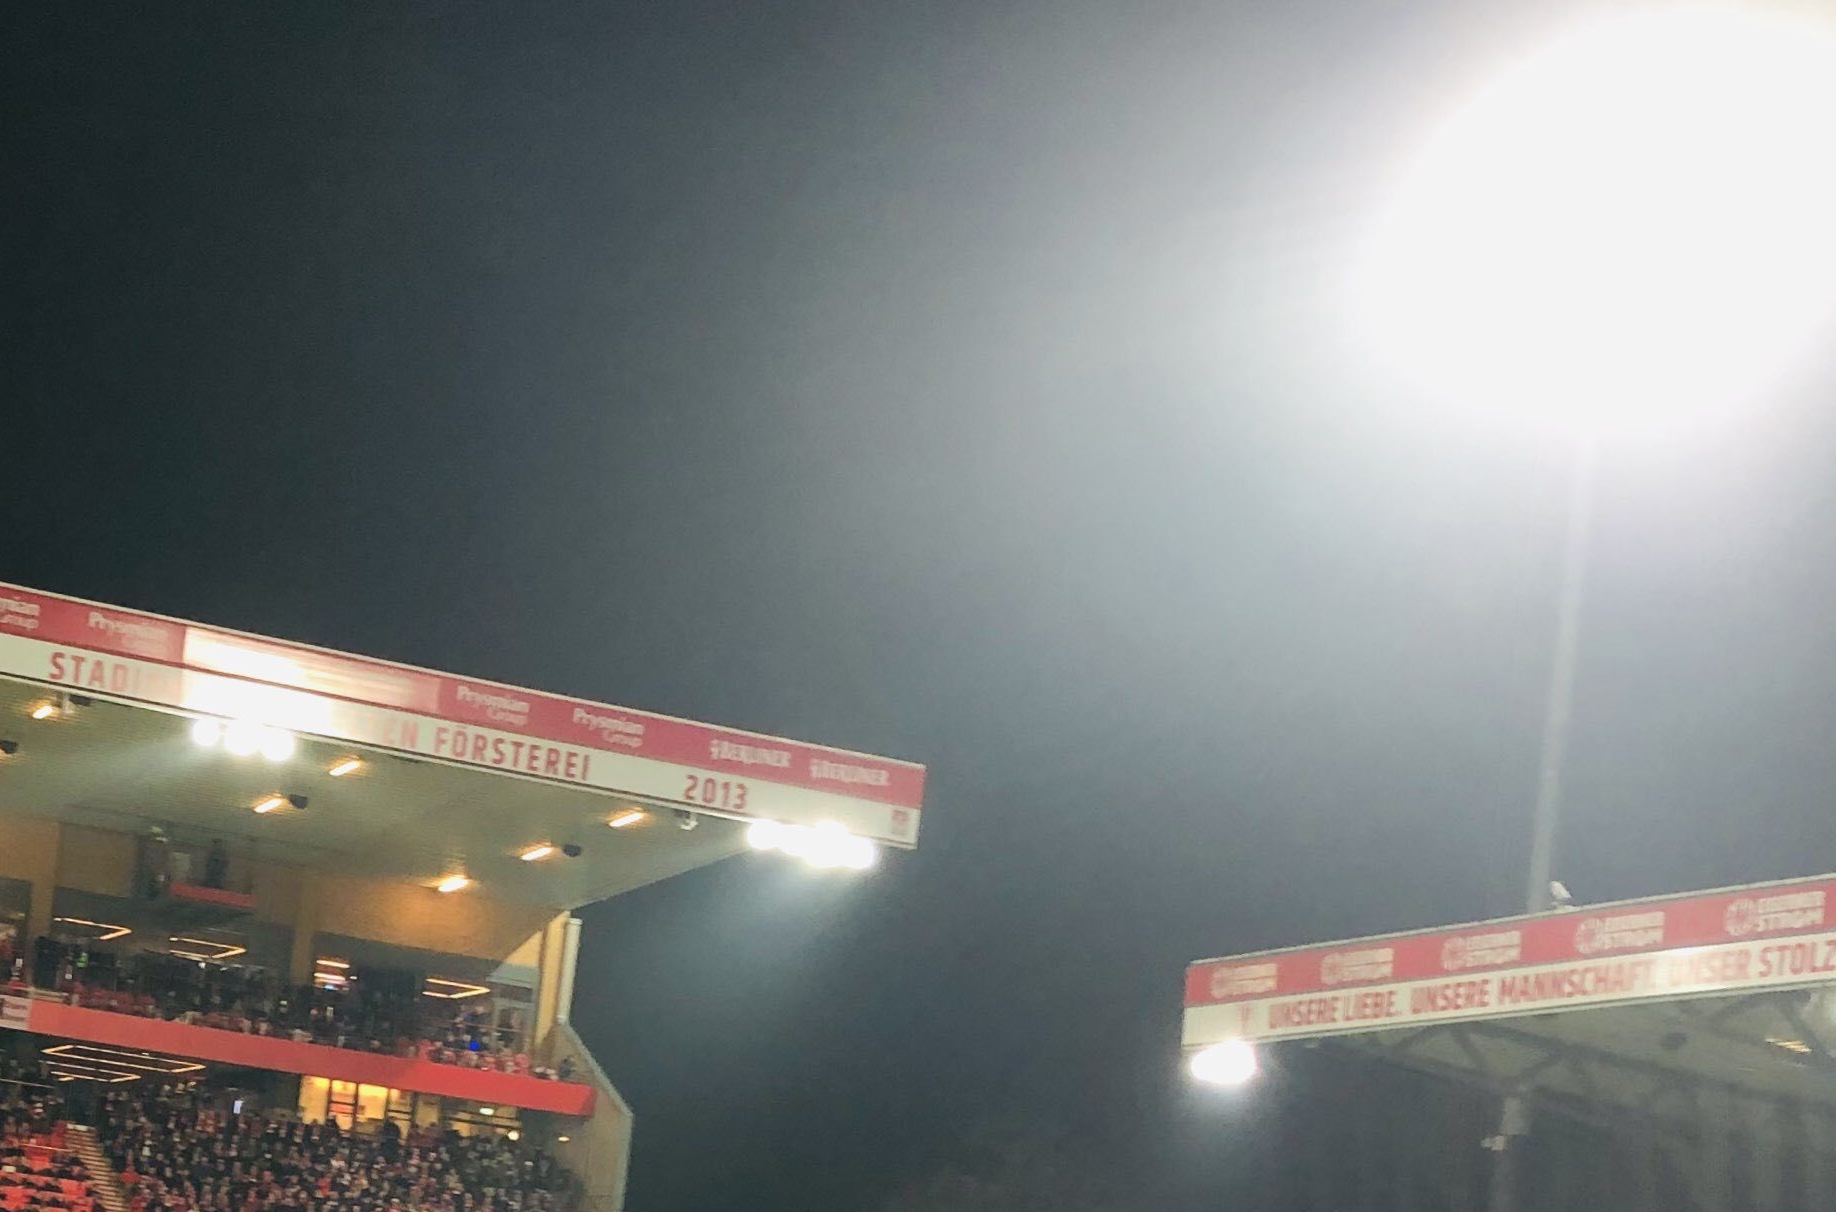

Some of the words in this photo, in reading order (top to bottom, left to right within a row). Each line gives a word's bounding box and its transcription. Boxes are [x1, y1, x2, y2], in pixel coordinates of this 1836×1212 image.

[435, 722, 591, 781] FÖRSTEREI
[683, 774, 749, 809] 2013
[1411, 978, 1490, 1014] UNSERE
